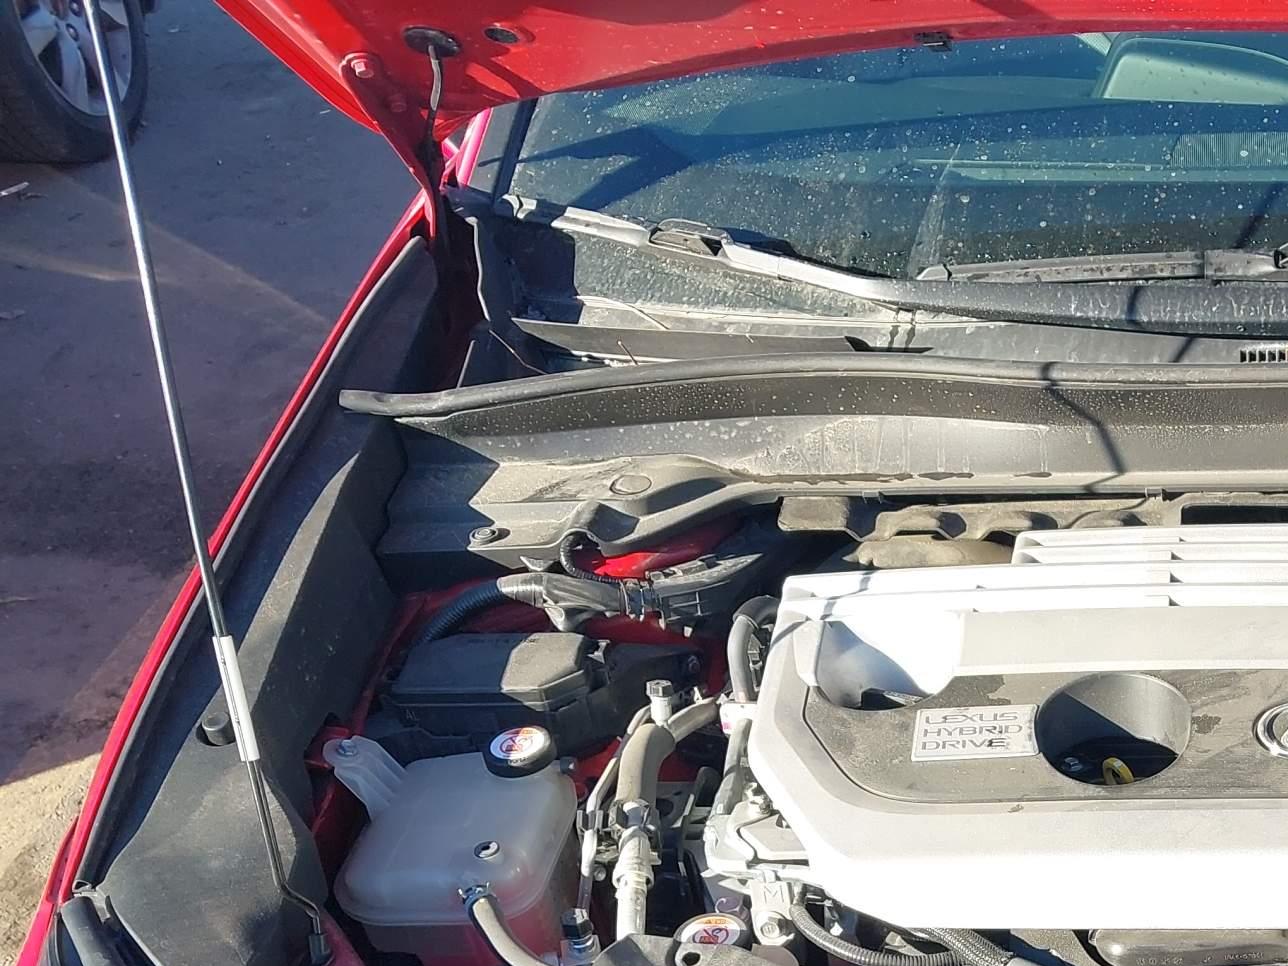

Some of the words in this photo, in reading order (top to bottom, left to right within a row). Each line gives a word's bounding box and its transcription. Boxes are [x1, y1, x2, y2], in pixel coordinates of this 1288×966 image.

[924, 711, 1019, 725] LEXUS
[922, 724, 1024, 738] HYBRID
[920, 738, 1008, 751] DRIVE
